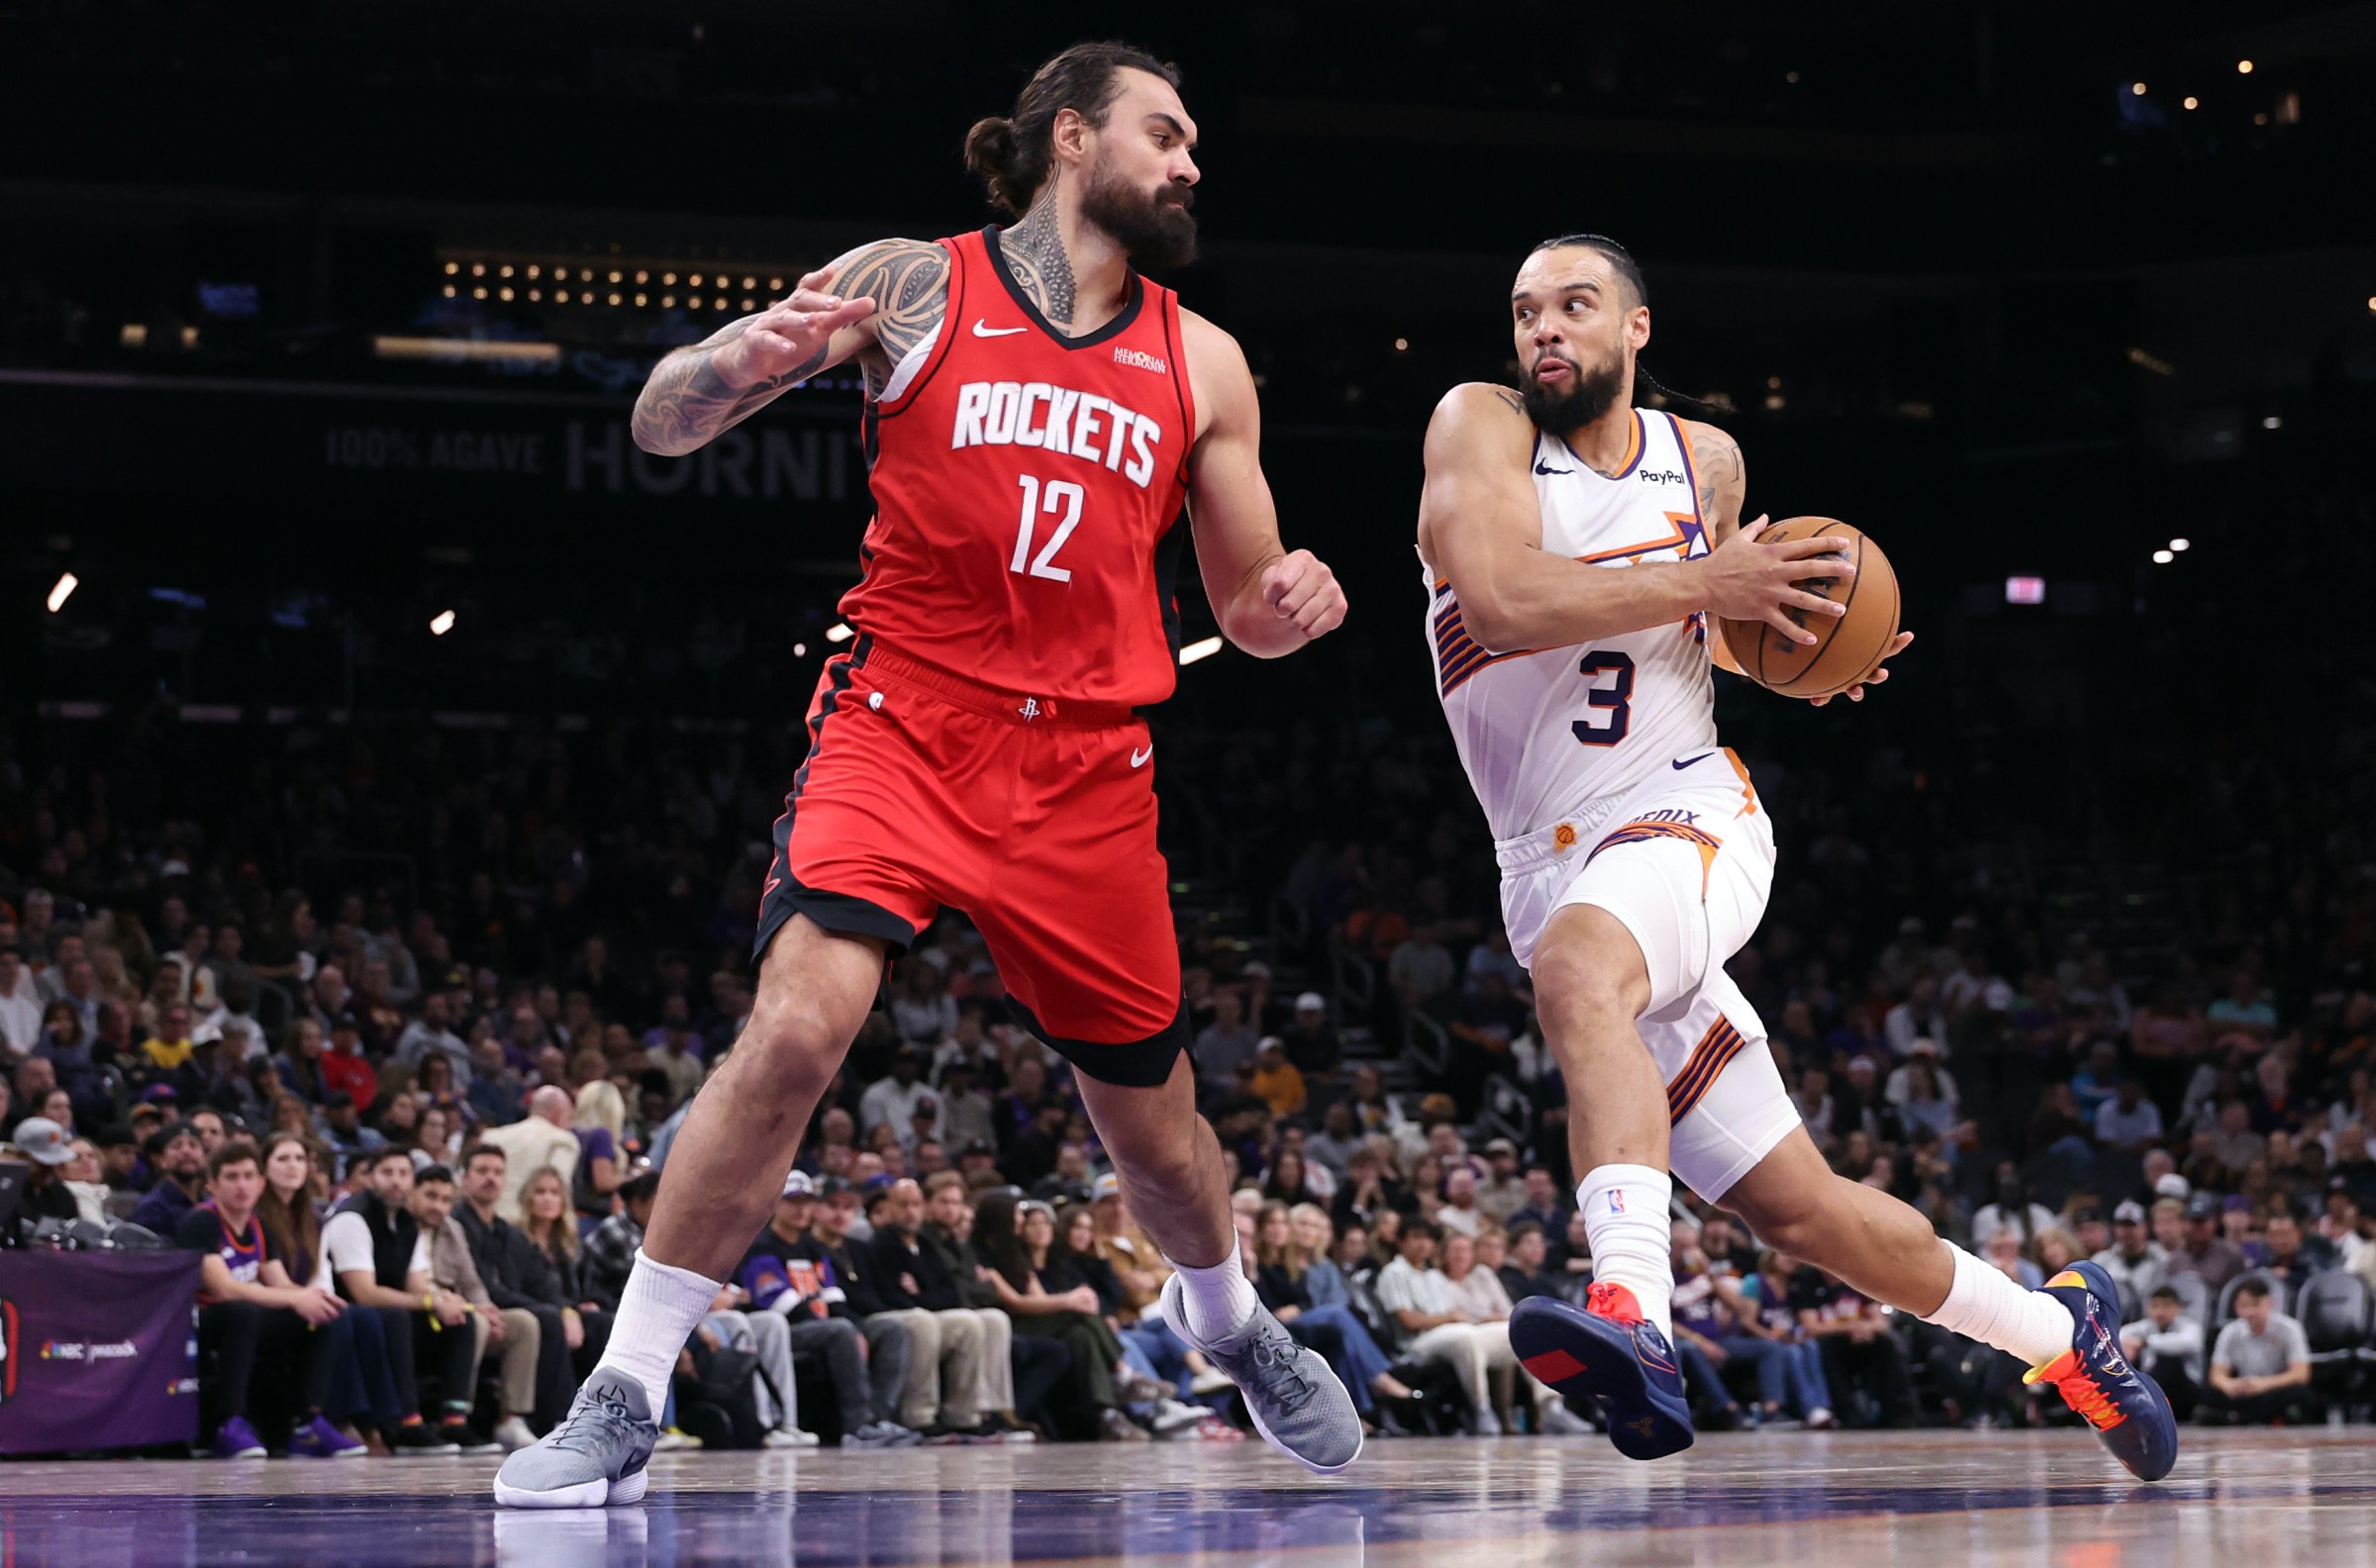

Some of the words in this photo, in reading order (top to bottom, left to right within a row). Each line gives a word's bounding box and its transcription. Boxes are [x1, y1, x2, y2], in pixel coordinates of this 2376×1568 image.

[1114, 345, 1165, 367] MEMORIAL
[1114, 354, 1166, 374] HERMANN
[326, 426, 421, 469] 100%
[430, 430, 543, 474] AGAVE
[565, 420, 864, 501] HORNI
[951, 381, 1161, 489] ROCKETS
[1639, 469, 1685, 486] PayPal
[1010, 474, 1084, 583] 12
[1571, 650, 1635, 747] 3
